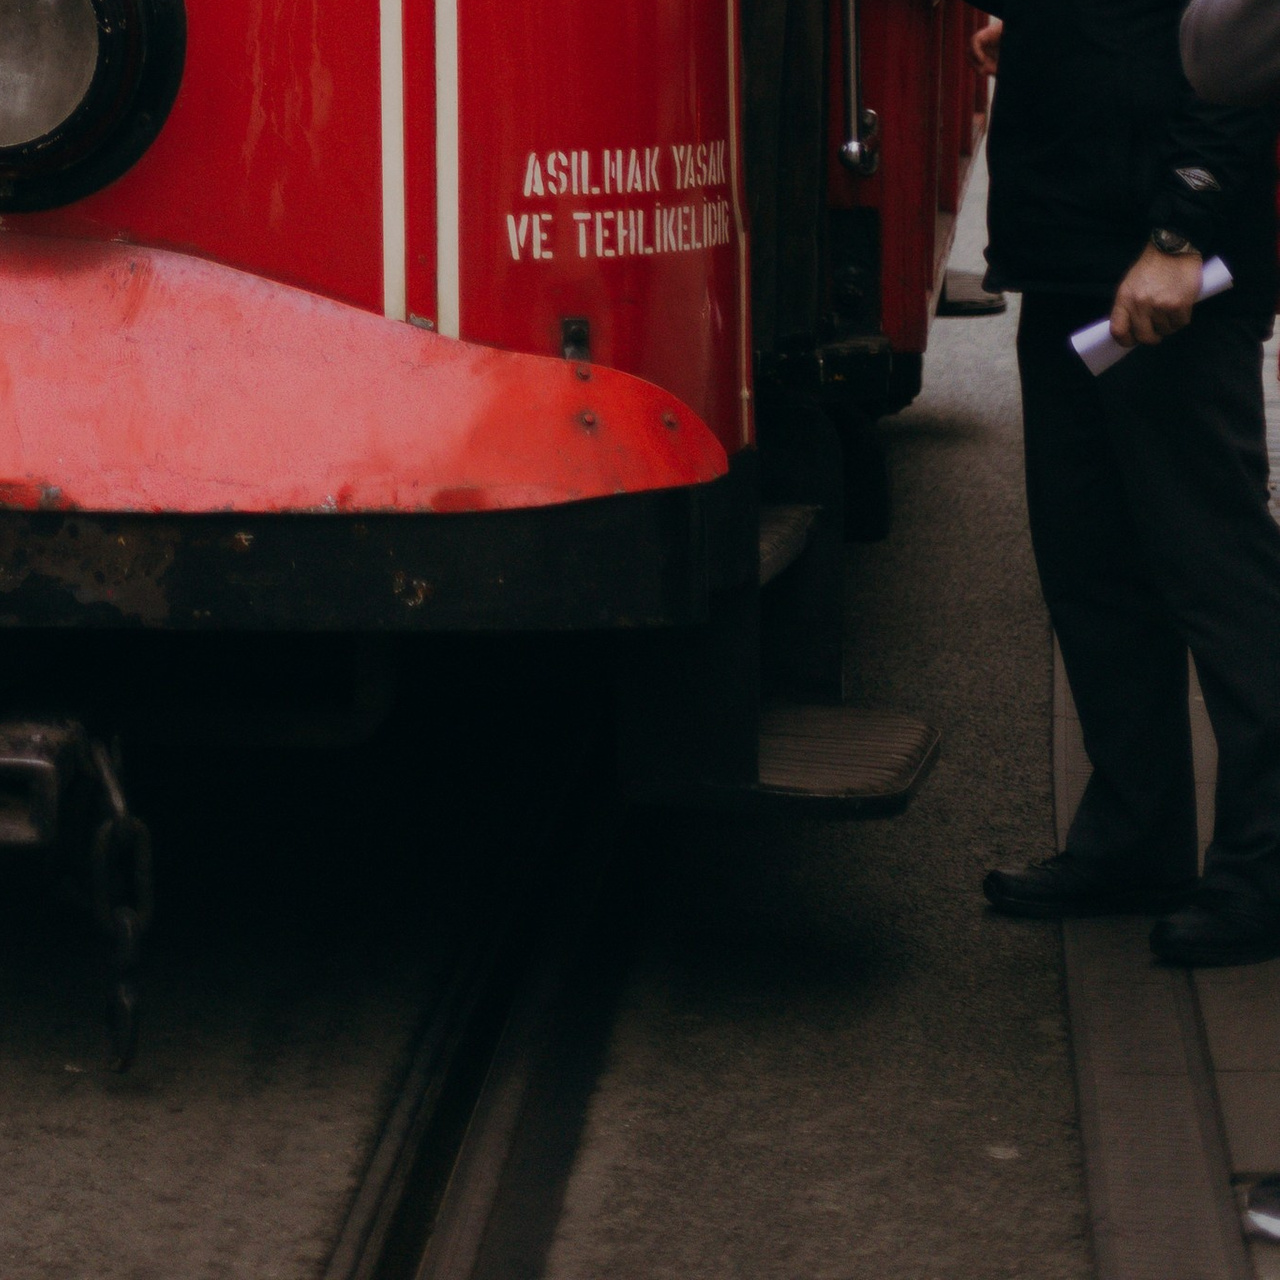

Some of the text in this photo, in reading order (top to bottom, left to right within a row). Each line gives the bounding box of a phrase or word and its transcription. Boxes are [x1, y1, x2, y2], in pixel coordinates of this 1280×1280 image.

[523, 140, 726, 197] ASILMAK YASAK
[507, 194, 730, 261] VE TEHLİKELİDİR
